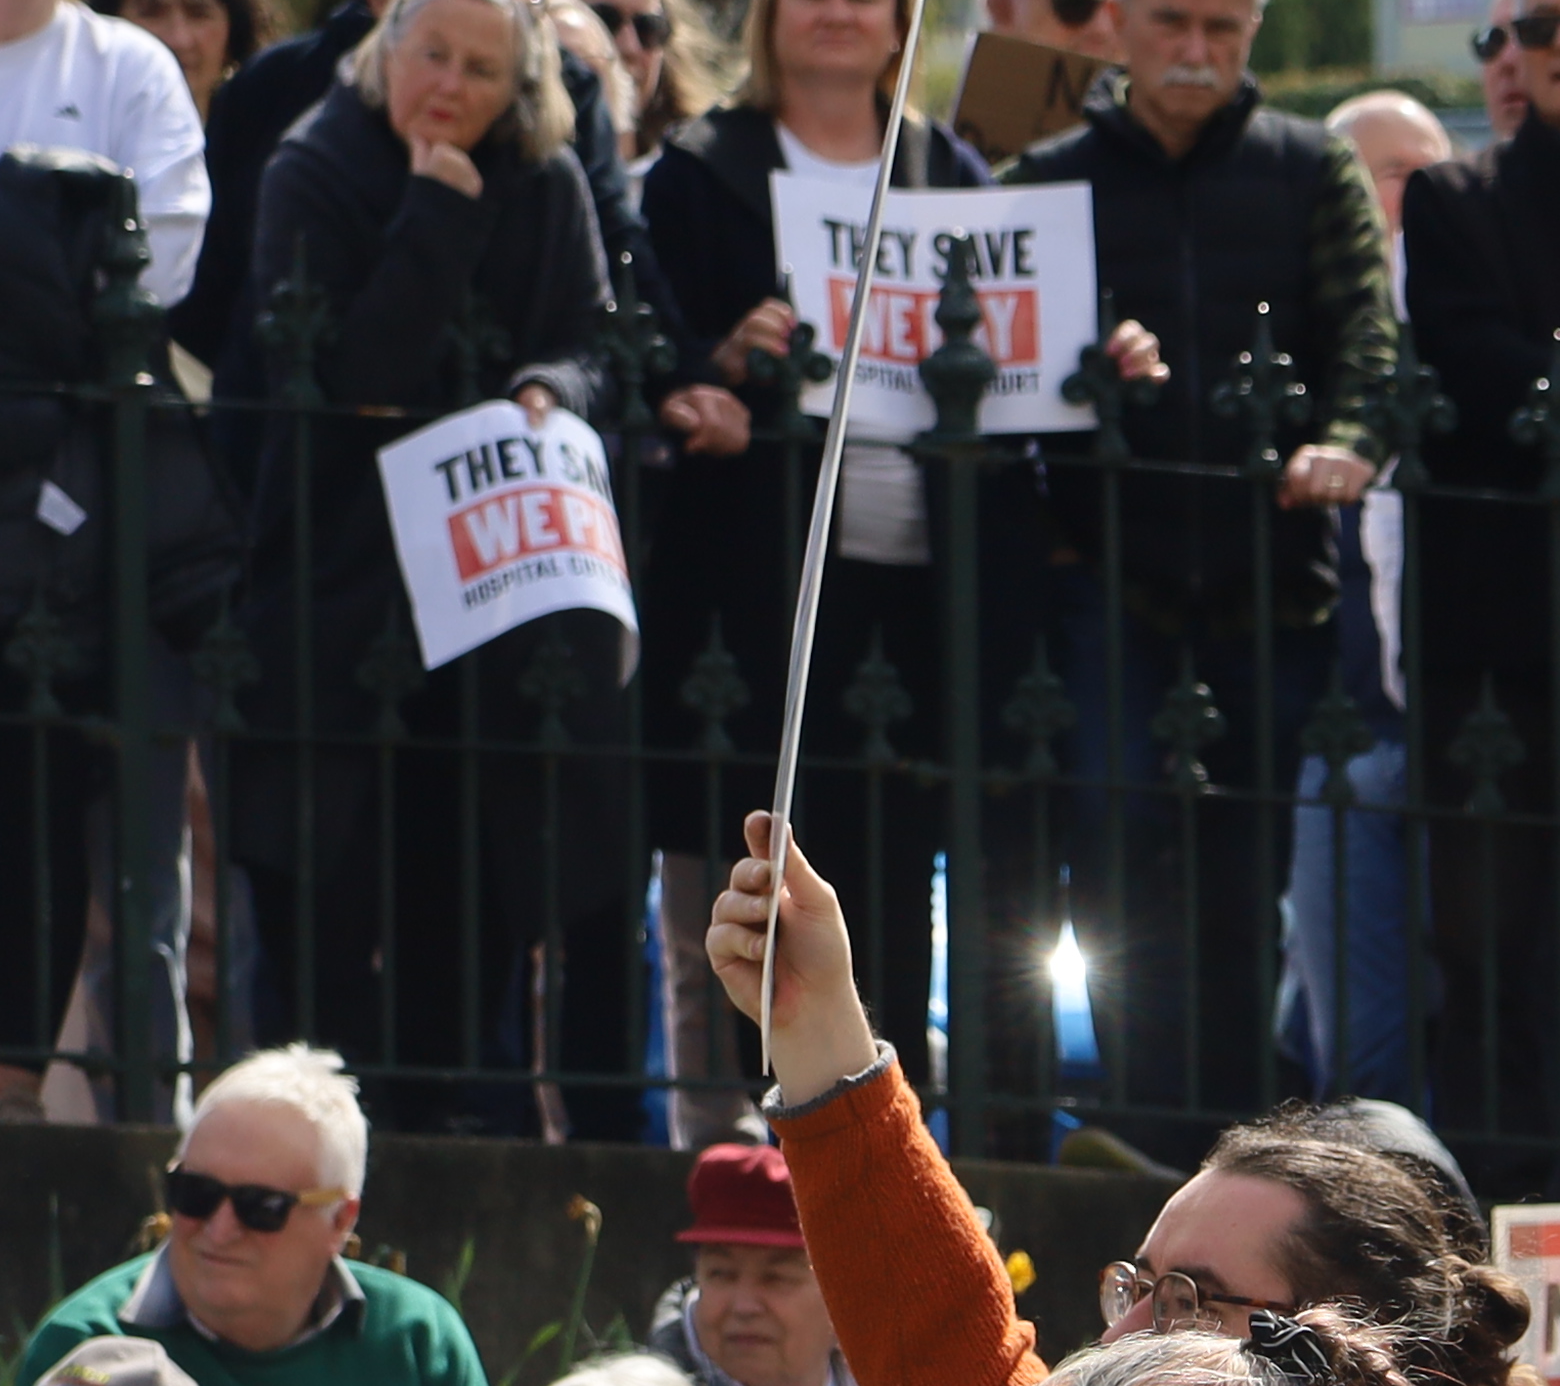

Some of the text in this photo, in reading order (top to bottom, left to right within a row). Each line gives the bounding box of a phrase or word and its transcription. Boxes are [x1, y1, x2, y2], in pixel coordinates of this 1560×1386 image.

[834, 360, 919, 394] SPITAL
[435, 436, 612, 503] THEY SA
[462, 491, 620, 565] WE PA
[463, 556, 564, 611] HOSPITAL
